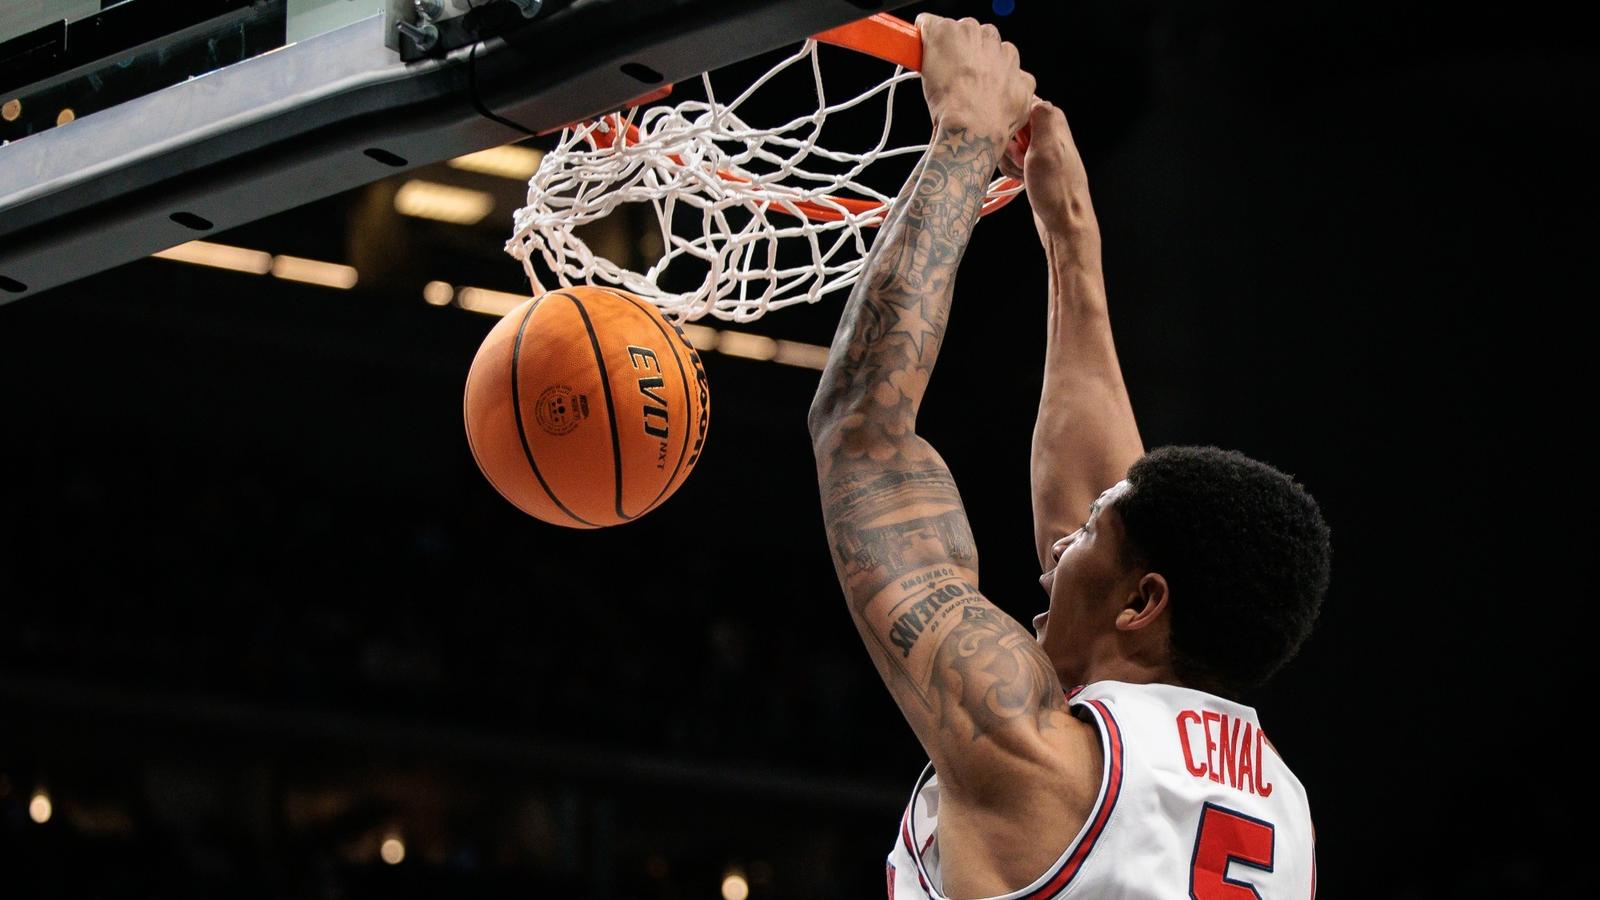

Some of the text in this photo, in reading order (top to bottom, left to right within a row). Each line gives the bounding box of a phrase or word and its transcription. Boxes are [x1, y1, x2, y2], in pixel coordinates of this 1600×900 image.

[627, 345, 669, 469] EVO NXT
[889, 584, 964, 658] ORLEANS
[1176, 710, 1273, 798] CENAC
[1189, 801, 1275, 900] 5
